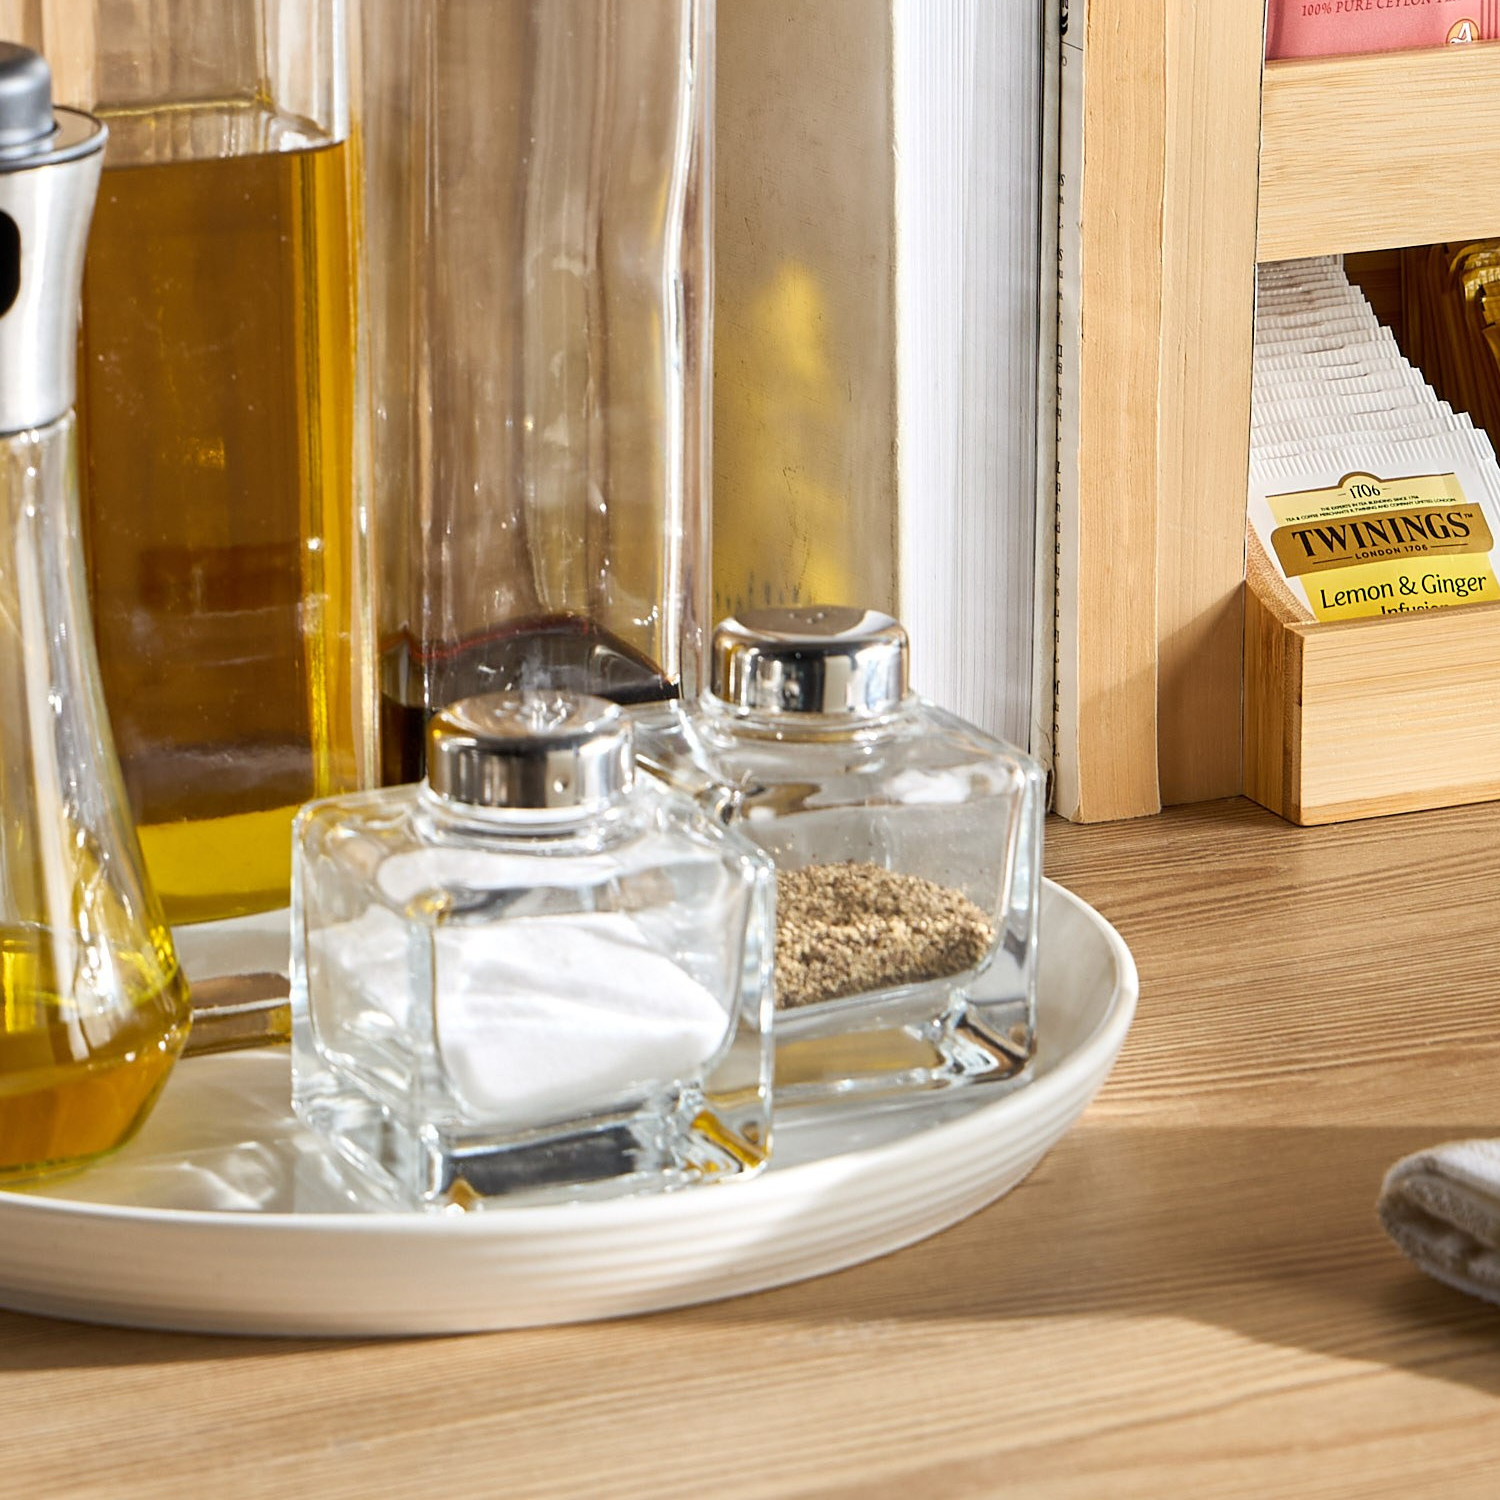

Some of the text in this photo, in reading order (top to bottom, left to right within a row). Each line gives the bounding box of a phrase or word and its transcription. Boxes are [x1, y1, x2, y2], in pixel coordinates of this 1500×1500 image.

[1302, 3, 1332, 17] 100%
[1349, 484, 1381, 499] 1706
[1355, 544, 1428, 560] LONDON 1706
[1320, 583, 1394, 609] Lemon
[1399, 575, 1418, 595] &
[1421, 573, 1487, 598] Ginger
